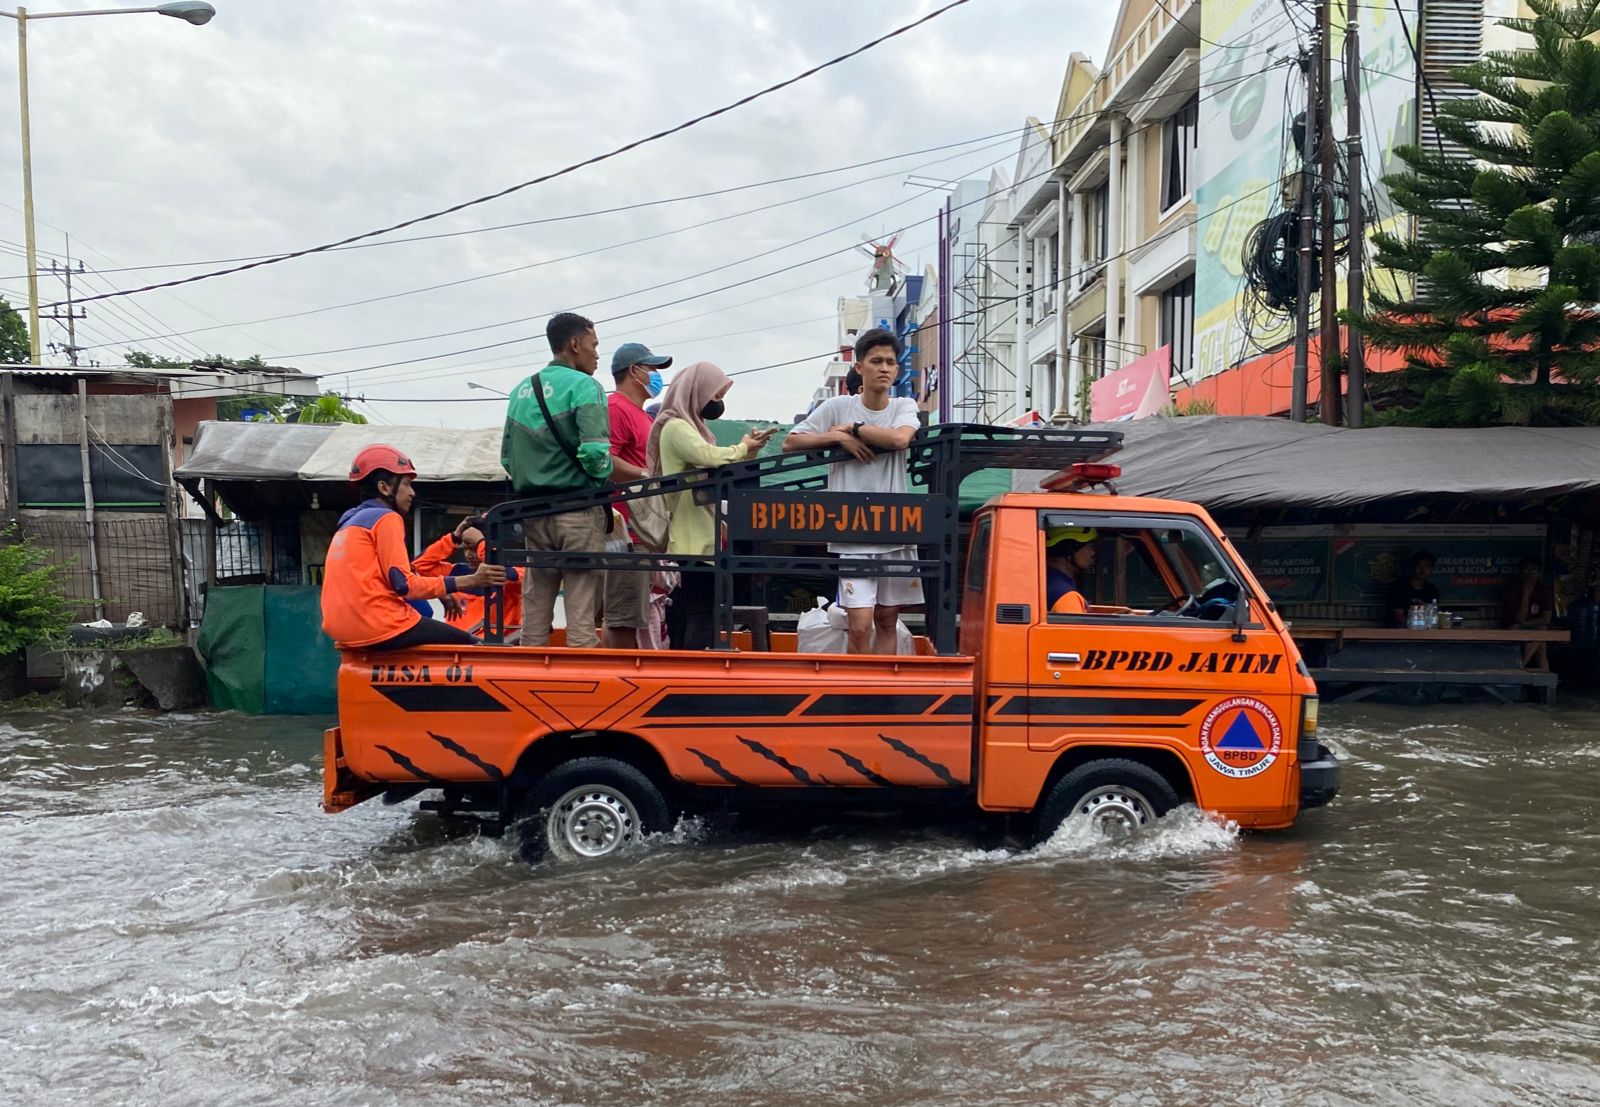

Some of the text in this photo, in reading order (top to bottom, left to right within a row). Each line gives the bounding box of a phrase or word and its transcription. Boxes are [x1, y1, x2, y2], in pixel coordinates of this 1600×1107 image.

[517, 381, 554, 400] Grb
[751, 502, 923, 533] BPBD-JATIM
[1081, 650, 1282, 674] BPBD JATIM
[370, 664, 474, 683] ELSA 01
[1223, 750, 1258, 761] BPBD
[1208, 757, 1271, 776] JAWA TIMUR
